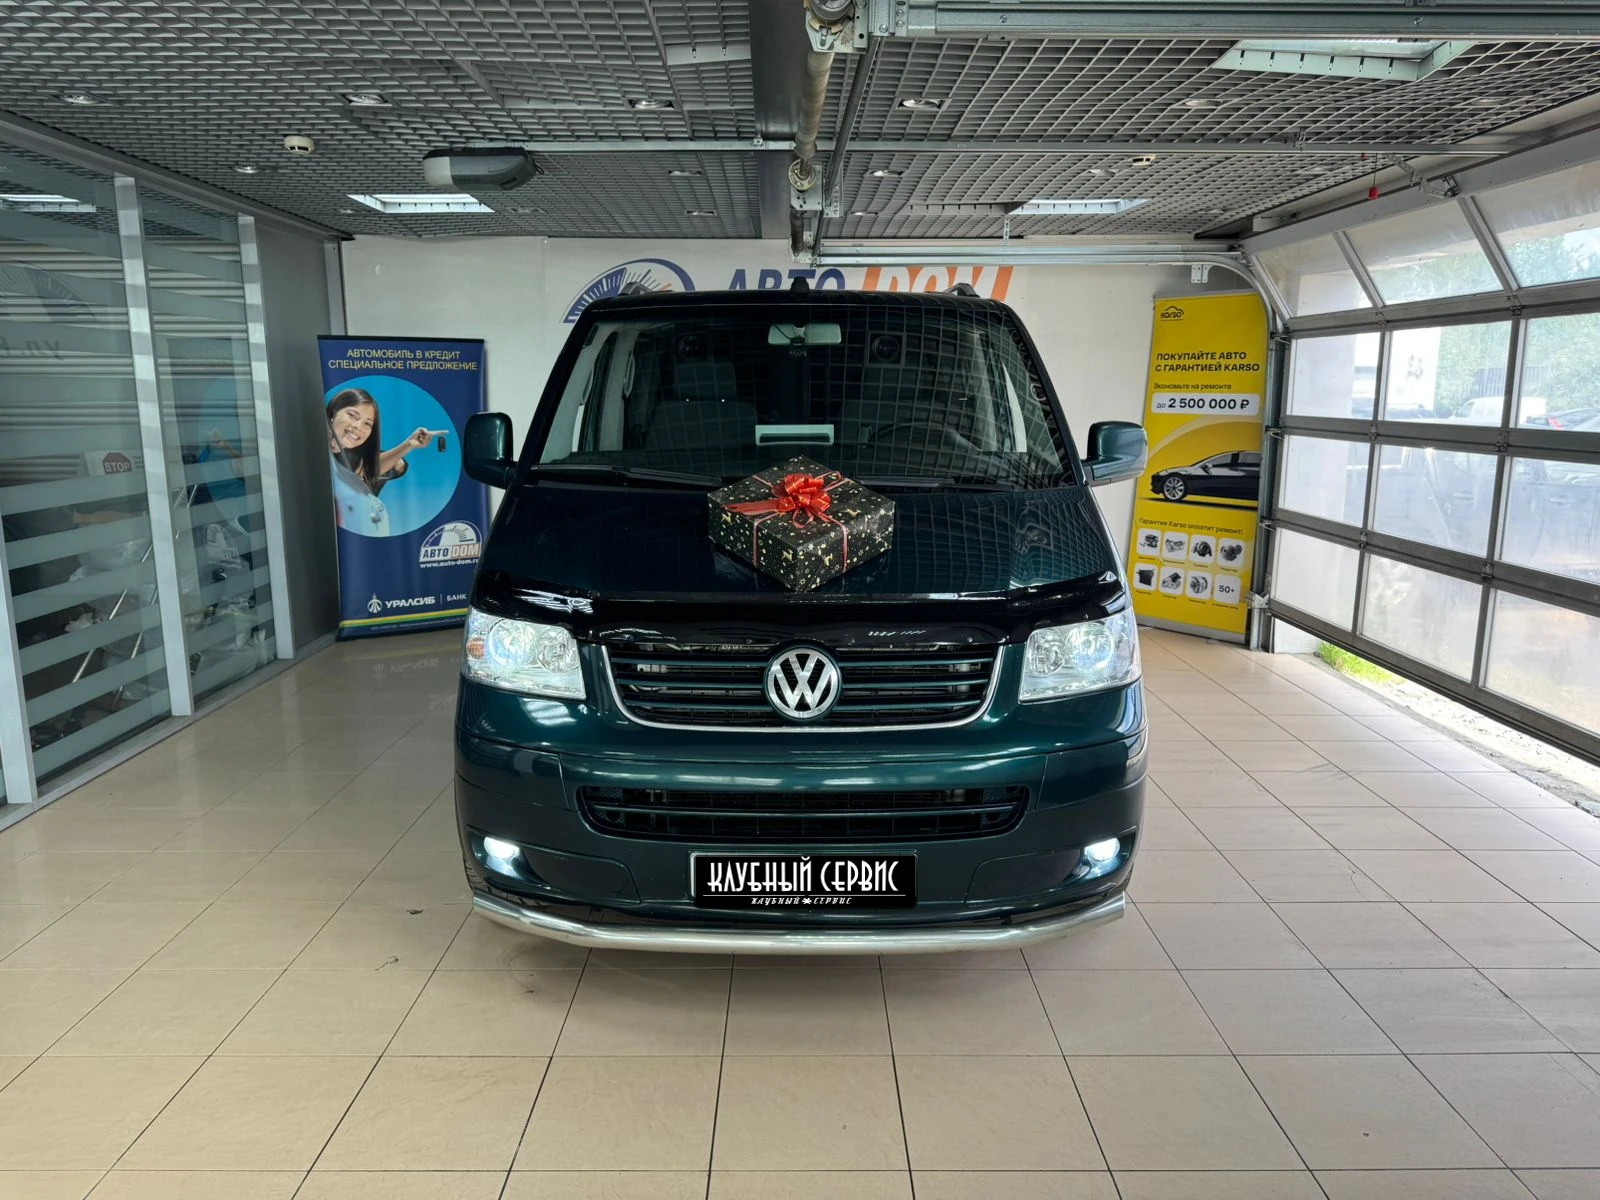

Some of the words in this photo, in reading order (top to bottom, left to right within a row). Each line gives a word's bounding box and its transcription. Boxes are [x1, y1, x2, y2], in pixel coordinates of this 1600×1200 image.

[347, 349, 414, 359] АВТОМОБИЛЬ
[416, 350, 423, 359] В
[425, 351, 461, 360] КРЕДИТ
[1156, 351, 1216, 361] ПОКУПАЙТЕ
[1218, 352, 1247, 360] АВТО
[328, 360, 404, 370] СПЕЦИАЛЬНОЕ
[406, 361, 478, 371] ПРЕДЛОЖЕНИЕ
[1164, 362, 1222, 372] ГАРАНТИЕЙ
[1224, 363, 1260, 372] KARSO
[1200, 383, 1232, 391] ремонте
[1168, 398, 1176, 408] 2
[1179, 398, 1205, 409] 500
[1209, 399, 1237, 409] 000
[104, 462, 130, 473] STOP
[1139, 517, 1168, 527] Гарантия
[1187, 523, 1215, 532] оплатит
[423, 547, 449, 559] АВТО
[452, 544, 479, 557] DOM
[1219, 585, 1235, 594] 50+
[385, 596, 436, 608] УРАЛСИБ
[446, 594, 467, 602] БАНК
[767, 649, 838, 718] VW
